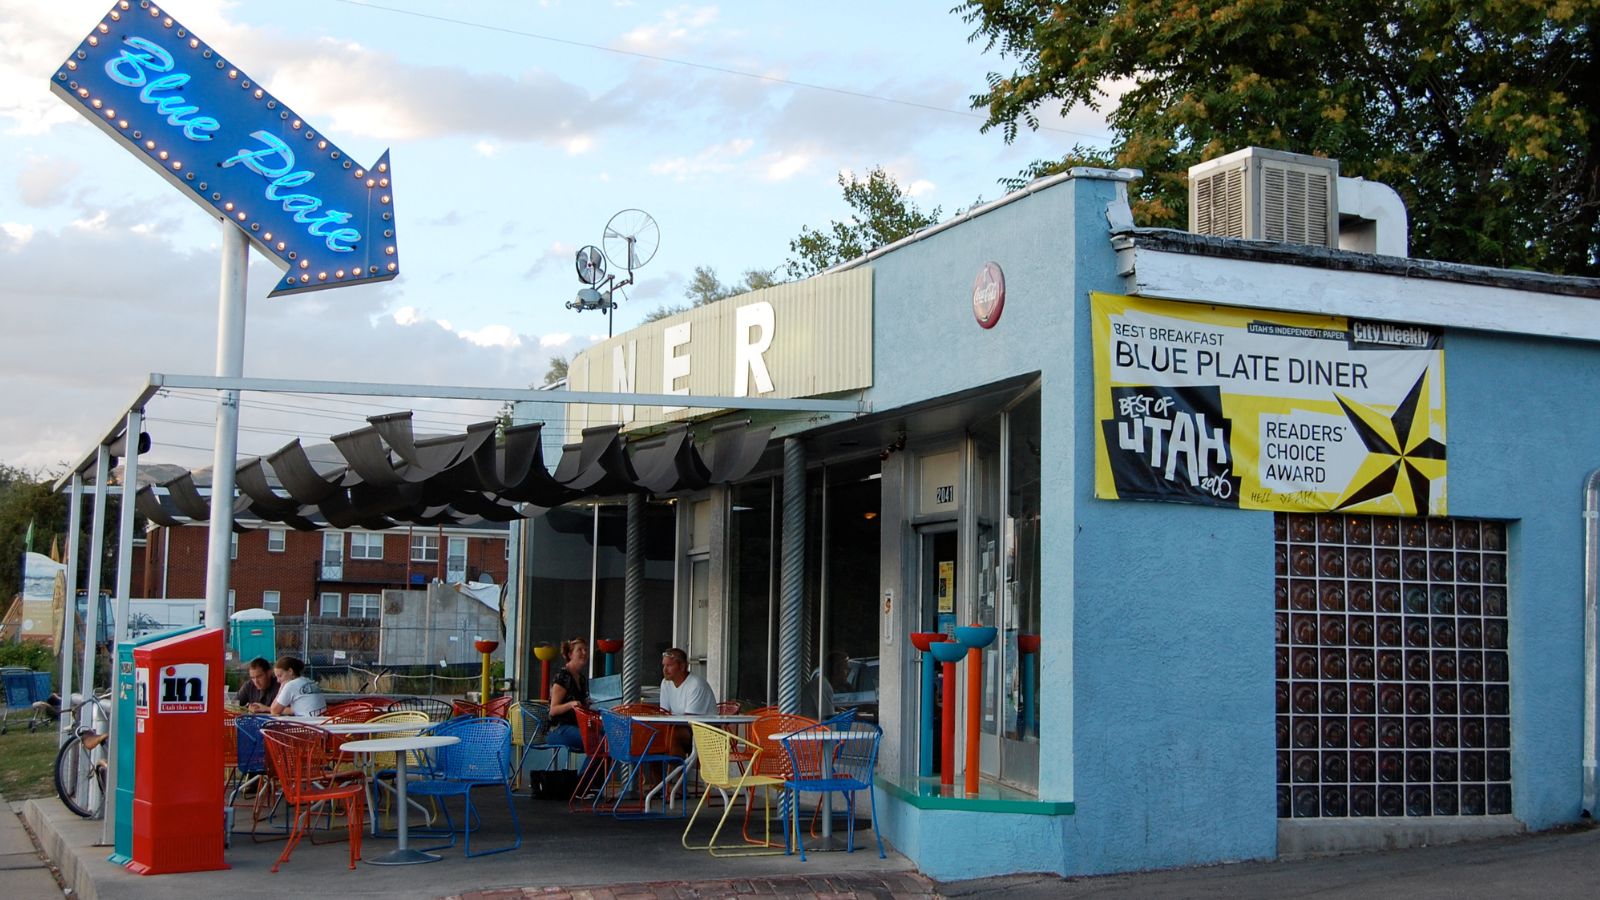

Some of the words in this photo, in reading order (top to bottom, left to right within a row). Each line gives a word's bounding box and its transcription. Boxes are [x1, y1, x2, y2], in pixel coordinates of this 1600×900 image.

[105, 37, 220, 140] Blue
[221, 130, 361, 252] Plate
[1114, 323, 1145, 338] BEST
[1150, 328, 1224, 346] BREAKFAST
[1250, 325, 1274, 334] UTAH'S
[1275, 327, 1322, 338] INDEPENDENT
[1323, 331, 1345, 340] PAPER
[1353, 322, 1383, 343] City
[1383, 326, 1430, 347] Weekly
[1116, 341, 1188, 374] BLUE
[1197, 350, 1280, 382] PLATE
[1289, 358, 1368, 389] DINER
[1119, 394, 1154, 418] BEST
[1154, 396, 1175, 417] OF
[1266, 422, 1347, 442] READERS'
[1266, 443, 1326, 462] CHOICE
[1200, 469, 1232, 499] 2006
[1265, 464, 1326, 483] AWARD
[936, 486, 954, 504] 2041
[162, 666, 204, 702] in
